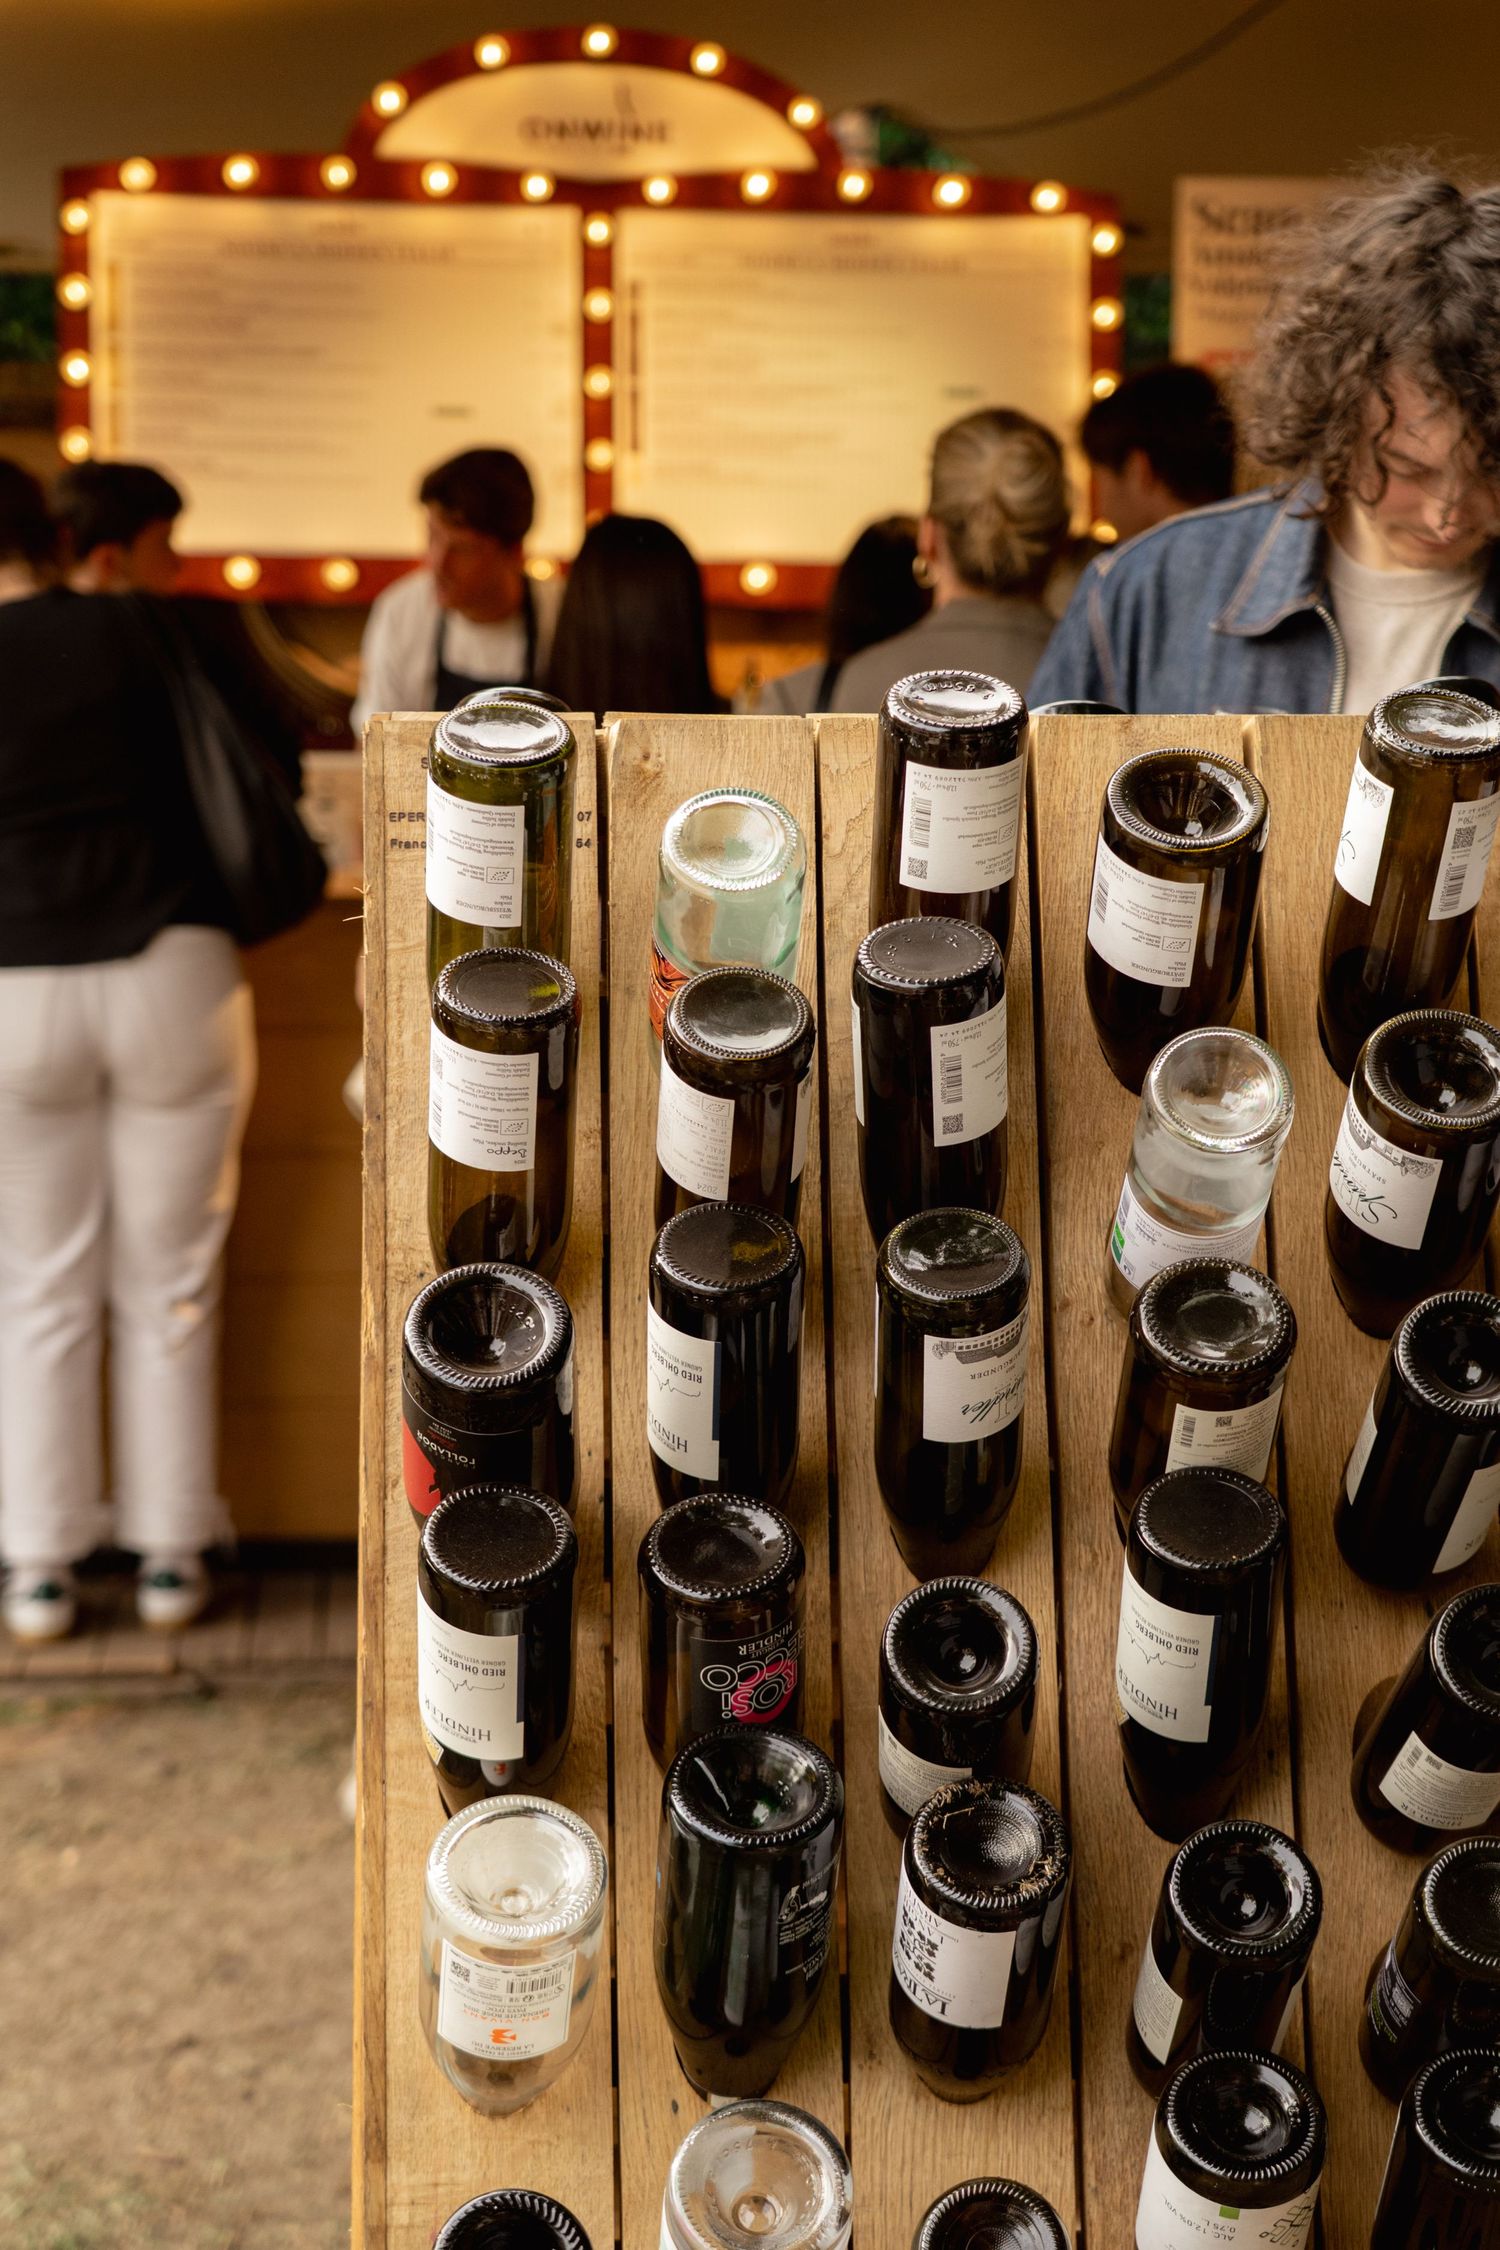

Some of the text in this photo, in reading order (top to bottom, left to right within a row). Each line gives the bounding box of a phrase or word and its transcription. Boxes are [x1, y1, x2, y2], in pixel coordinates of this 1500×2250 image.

[389, 811, 592, 822] EPER 07
[390, 839, 427, 849] Franc
[948, 1038, 959, 1048] 750
[487, 1147, 527, 1158] Beppo
[697, 1183, 718, 1195] 2024
[681, 1370, 702, 1384] RIED
[417, 1430, 475, 1465] FOLLADOR
[737, 1620, 792, 1656] HINDLER
[1135, 1619, 1199, 1656] RIED ÖHLBERG
[1147, 1621, 1174, 1642] VELTLINER
[1175, 1635, 1200, 1645] GRÜNER
[438, 1649, 506, 1677] RIED ÖHLBERG
[1118, 1664, 1178, 1720] HINDLER
[424, 1695, 490, 1742] HINDLER
[1213, 2222, 1236, 2233] 0.75
[1211, 2231, 1234, 2241] ALC.
